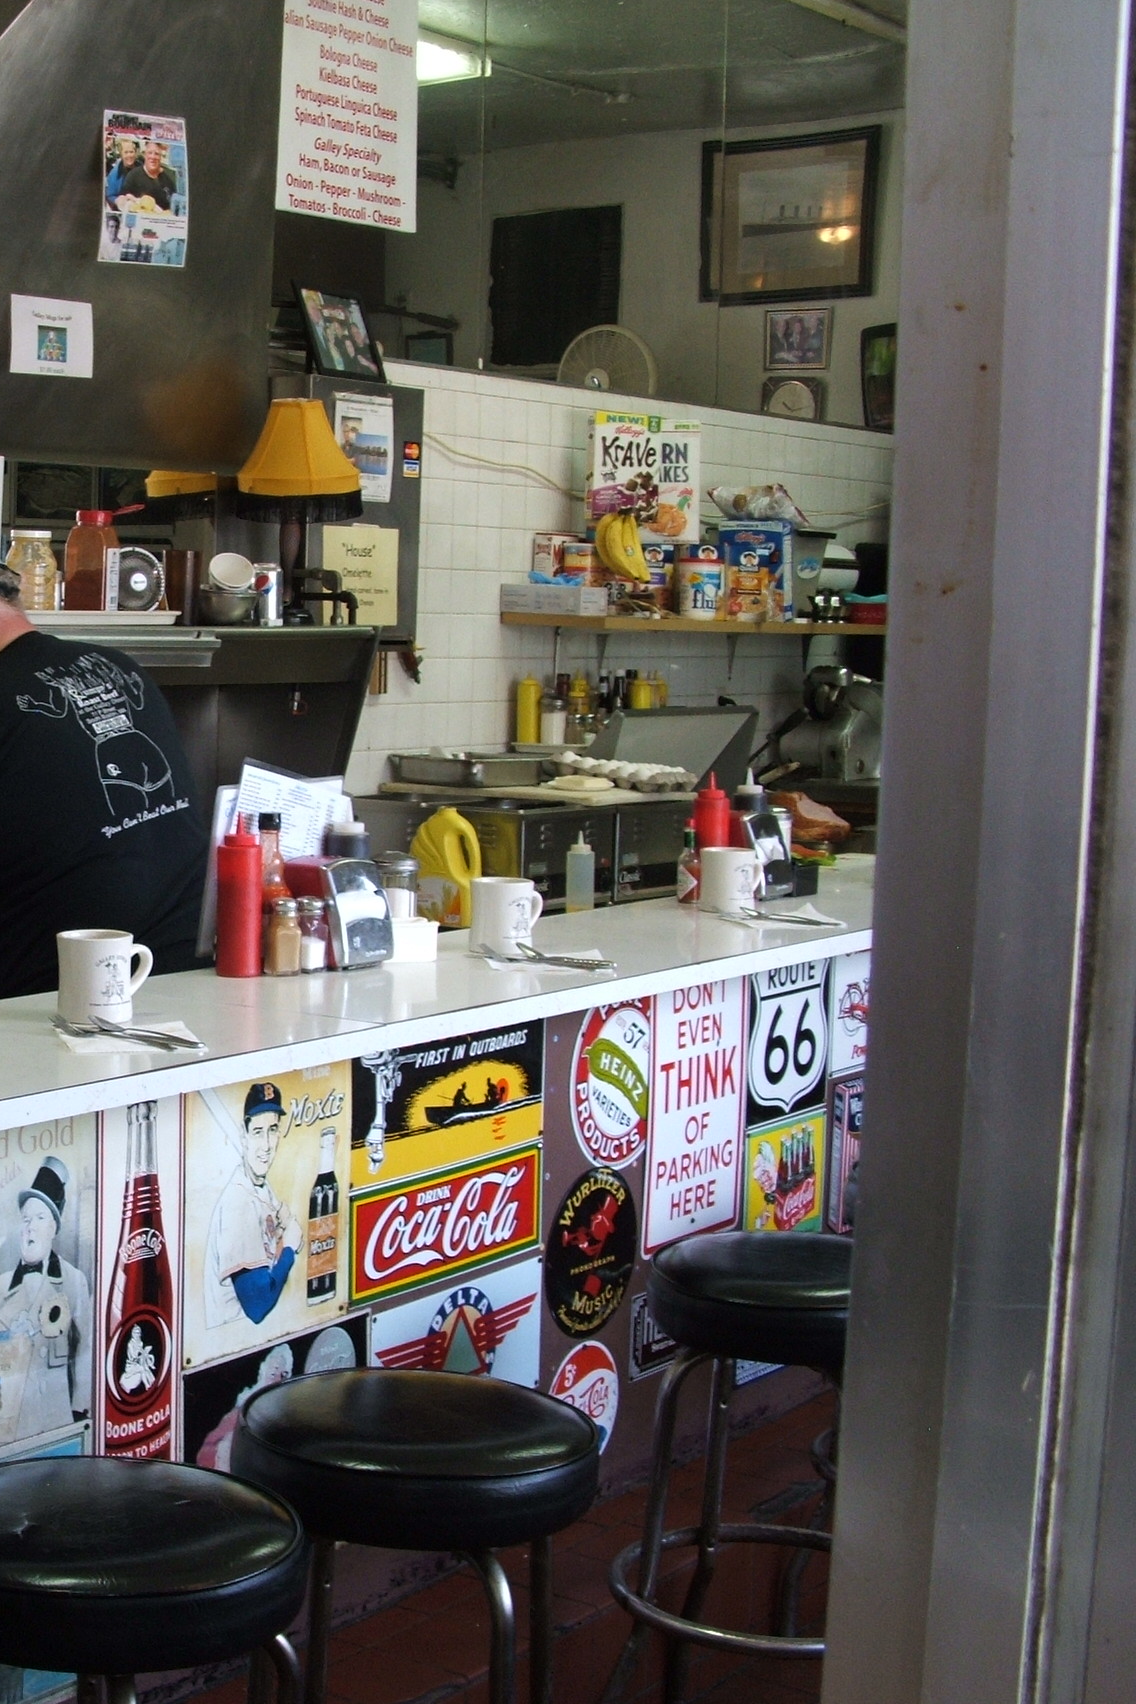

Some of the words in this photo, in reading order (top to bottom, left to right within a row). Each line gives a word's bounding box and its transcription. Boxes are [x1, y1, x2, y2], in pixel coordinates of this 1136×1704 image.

[339, 1, 356, 18] Hash
[365, 9, 389, 28] Cheese
[306, 14, 337, 39] Sausage
[339, 23, 364, 44] Pepper
[366, 31, 387, 49] Onion
[389, 37, 413, 57] Cheese
[320, 44, 351, 67] Bologna
[352, 53, 378, 73] Cheese
[319, 67, 350, 88] Kielbasa
[352, 75, 378, 94] Cheese
[296, 84, 339, 107] Portuguese
[341, 95, 371, 115] Linguica
[372, 102, 397, 121] Cheese
[295, 107, 325, 126] Spinach
[327, 114, 354, 133] Tomato
[356, 121, 371, 137] Feta
[372, 125, 397, 143] Cheese
[314, 137, 342, 157] Galley
[343, 143, 382, 165] Specialty
[299, 153, 322, 171] Ham,
[324, 159, 349, 175] Bacon
[351, 167, 361, 177] or
[362, 166, 396, 187] Sausage
[286, 173, 313, 190] Onion
[320, 180, 351, 198] Pepper
[357, 187, 401, 207] Mushroom
[289, 194, 326, 213] Tomatos
[332, 202, 366, 220] Broccoli
[372, 210, 401, 227] Cheese
[607, 414, 645, 425] NEW!
[661, 442, 688, 465] RN
[343, 569, 372, 579] Omelette
[767, 960, 816, 991] ROUTE
[673, 979, 727, 1015] DON'T
[623, 1022, 646, 1049] 57
[678, 1012, 722, 1050] EVEN
[764, 997, 817, 1086] 66
[415, 1047, 451, 1068] FIRST
[452, 1044, 467, 1061] IN
[469, 1029, 529, 1057] OUTBOARDS
[599, 1052, 644, 1102] HEINZ
[660, 1045, 737, 1114] THINK
[576, 1082, 641, 1159] PRODUCTS
[592, 1085, 632, 1128] VARIETIES
[18, 1116, 74, 1155] Gold
[684, 1112, 711, 1145] OF
[655, 1139, 733, 1190] PARKING
[416, 1185, 452, 1206] DRINK
[559, 1168, 627, 1227] WURLITZER
[670, 1179, 717, 1220] HERE
[364, 1165, 526, 1280] Coca-Cola
[570, 1255, 616, 1276] PHONOGRAPH
[431, 1288, 489, 1332] DELTA
[571, 1284, 614, 1315] MUSIC
[106, 1418, 144, 1438] BOONE
[146, 1404, 170, 1428] COLA
[135, 1446, 148, 1457] TO
